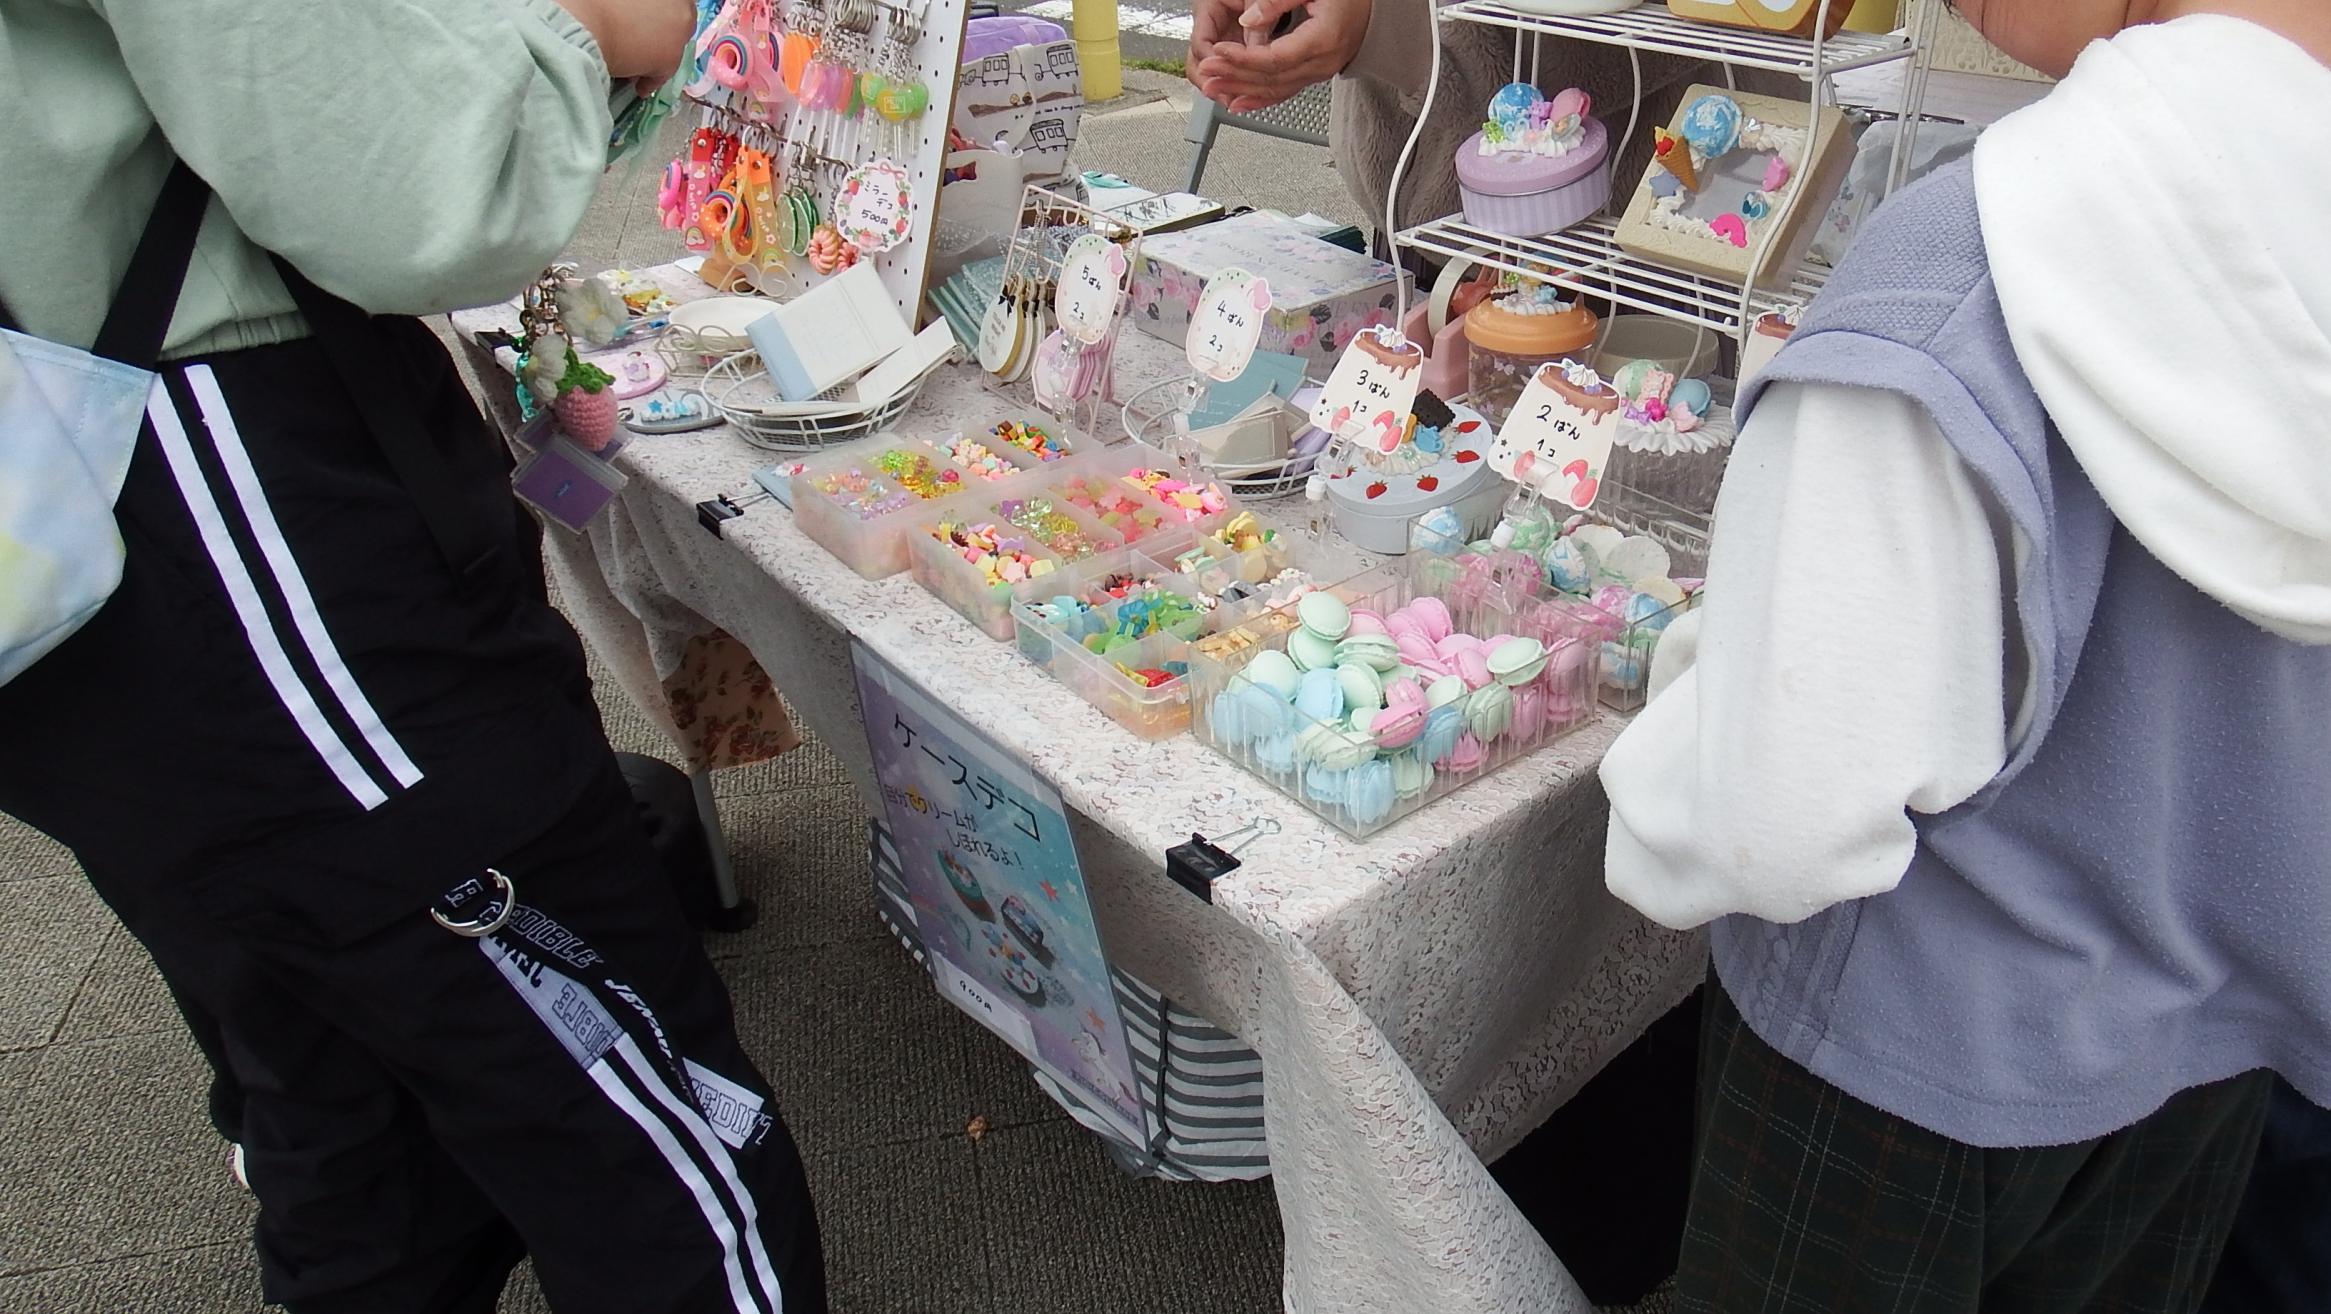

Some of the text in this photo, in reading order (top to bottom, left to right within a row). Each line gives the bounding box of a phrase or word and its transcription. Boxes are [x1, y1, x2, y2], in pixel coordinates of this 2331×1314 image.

[861, 209, 888, 225] 500円
[1217, 300, 1244, 328] 4ばん
[1357, 369, 1390, 399] 3ばん
[1536, 404, 1581, 440] 2ばん
[894, 713, 1041, 842] ケースデコ
[960, 980, 993, 1013] 900円
